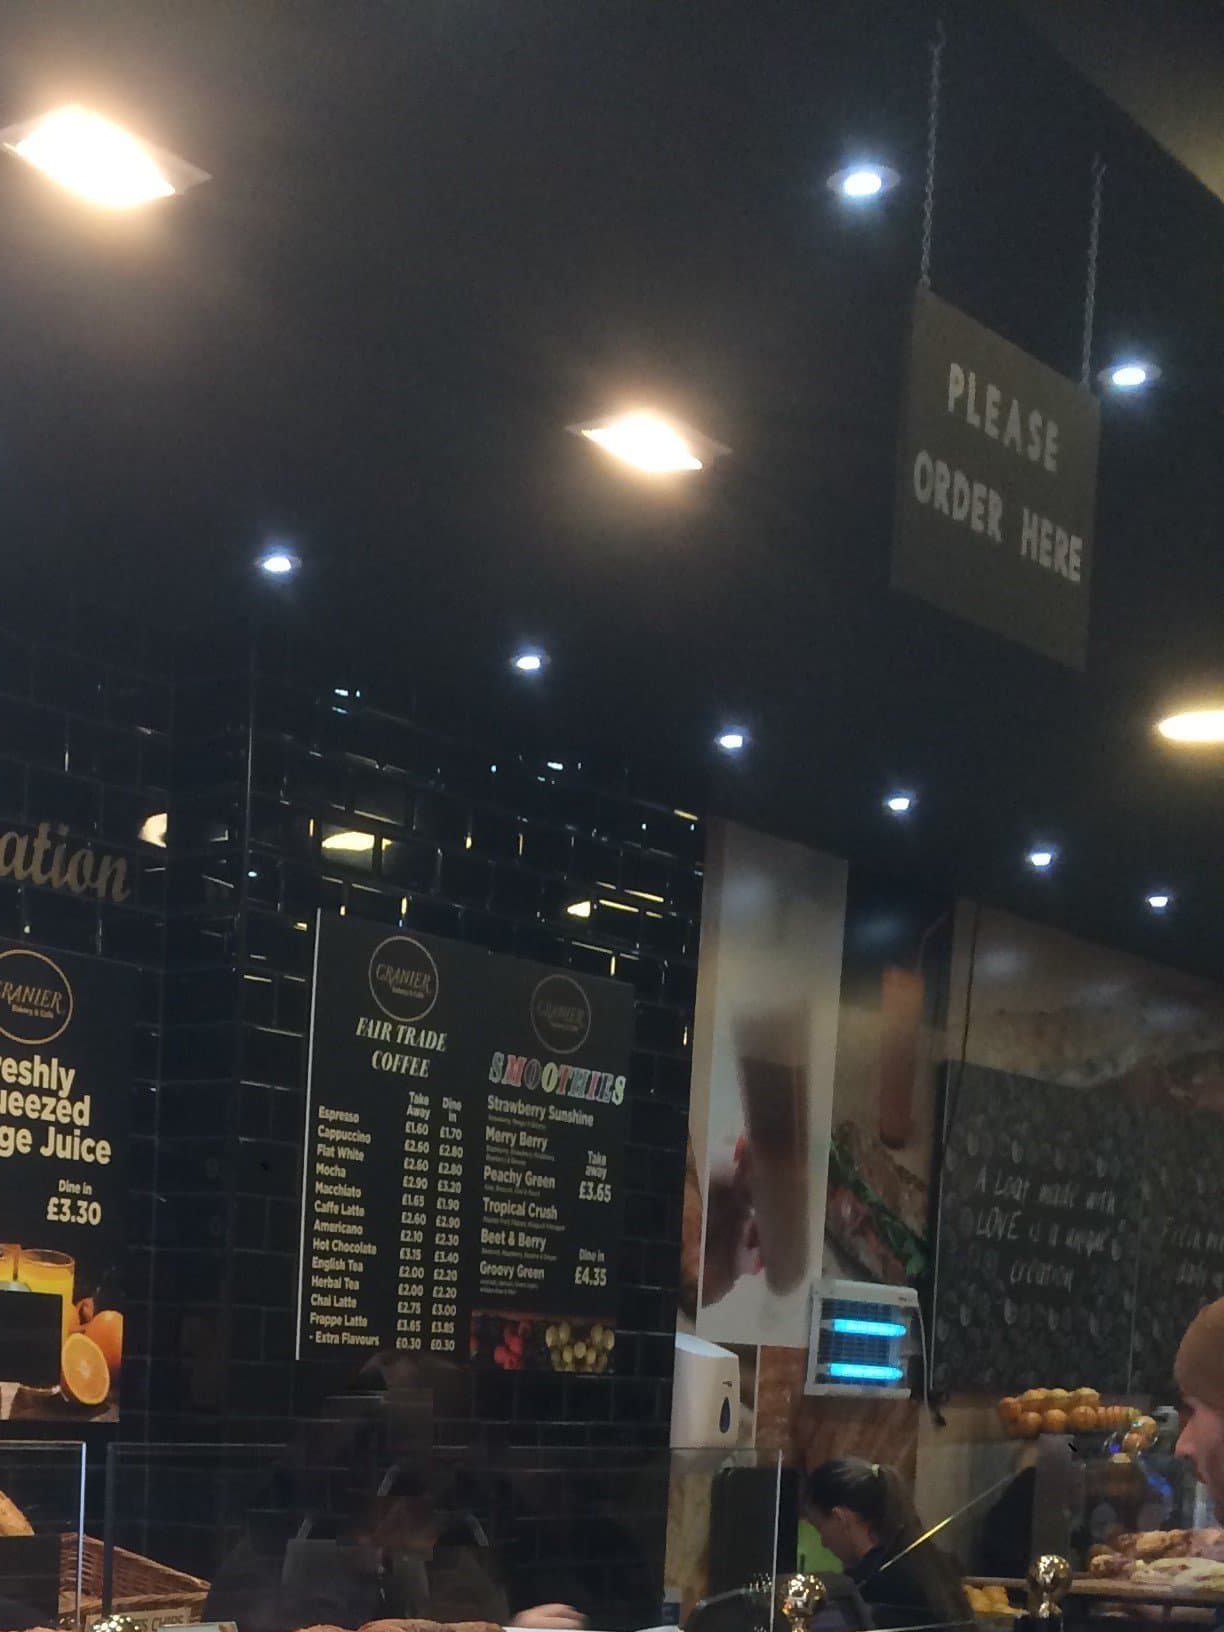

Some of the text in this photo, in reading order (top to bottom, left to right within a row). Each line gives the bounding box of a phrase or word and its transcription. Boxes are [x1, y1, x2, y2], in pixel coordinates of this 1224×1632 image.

[947, 361, 1059, 472] PLEASE
[913, 450, 1083, 583] ORDER HERE
[355, 1016, 448, 1053] FAIR TRADE
[371, 1050, 431, 1079] COFFEE
[488, 1051, 626, 1106] SMOOTHIES
[409, 1091, 429, 1106] Take
[443, 1097, 462, 1111] Dine
[487, 1094, 546, 1121] Strawberry
[549, 1105, 594, 1127] Sunshine
[319, 1106, 359, 1123] Espresso
[440, 1126, 462, 1140] £1.70
[407, 1105, 431, 1120] Away
[448, 1112, 457, 1122] in
[39, 1126, 112, 1166] Juice
[318, 1125, 371, 1144] Cappuccino
[405, 1139, 430, 1153] £2.60
[486, 1126, 548, 1151] Merry Berry
[317, 1144, 335, 1157] Flat
[338, 1145, 364, 1161] White
[404, 1157, 428, 1171] £2.60
[588, 1151, 607, 1166] Take
[316, 1163, 346, 1178] Mocha
[403, 1175, 428, 1190] £2.90
[484, 1166, 555, 1189] Peachy Green
[585, 1166, 607, 1180] away
[58, 1179, 93, 1195] Dine in
[315, 1182, 361, 1198] Macchiato
[437, 1198, 460, 1211] £1.90
[579, 1181, 612, 1203] £3.65
[46, 1196, 102, 1226] £3.30
[315, 1200, 460, 1228] Caffe Latte £2.60 £2.90
[483, 1197, 558, 1220] Tropical Crush
[314, 1219, 363, 1235] Americano
[401, 1230, 423, 1243] £2.10
[976, 1206, 1023, 1240] LOVE
[313, 1238, 329, 1250] Hot
[332, 1240, 377, 1255] Chocolate
[434, 1251, 459, 1264] £3.40
[481, 1228, 546, 1252] Beet & Berry
[579, 1248, 605, 1262] Dine in
[312, 1256, 345, 1271] English
[348, 1260, 363, 1272] Tea
[399, 1266, 424, 1279] £2.00
[480, 1261, 545, 1280] Groovy Green
[575, 1266, 607, 1286] £4.35
[312, 1275, 342, 1289] Herbal
[344, 1277, 359, 1290] Tea
[398, 1284, 424, 1296] £2.00
[311, 1294, 331, 1307] Chai
[334, 1296, 357, 1309] Latte
[432, 1304, 456, 1316] £3.00
[310, 1312, 342, 1328] Frappe
[345, 1314, 368, 1327] Latte
[316, 1331, 339, 1344] Extra
[342, 1333, 379, 1346] Flavours
